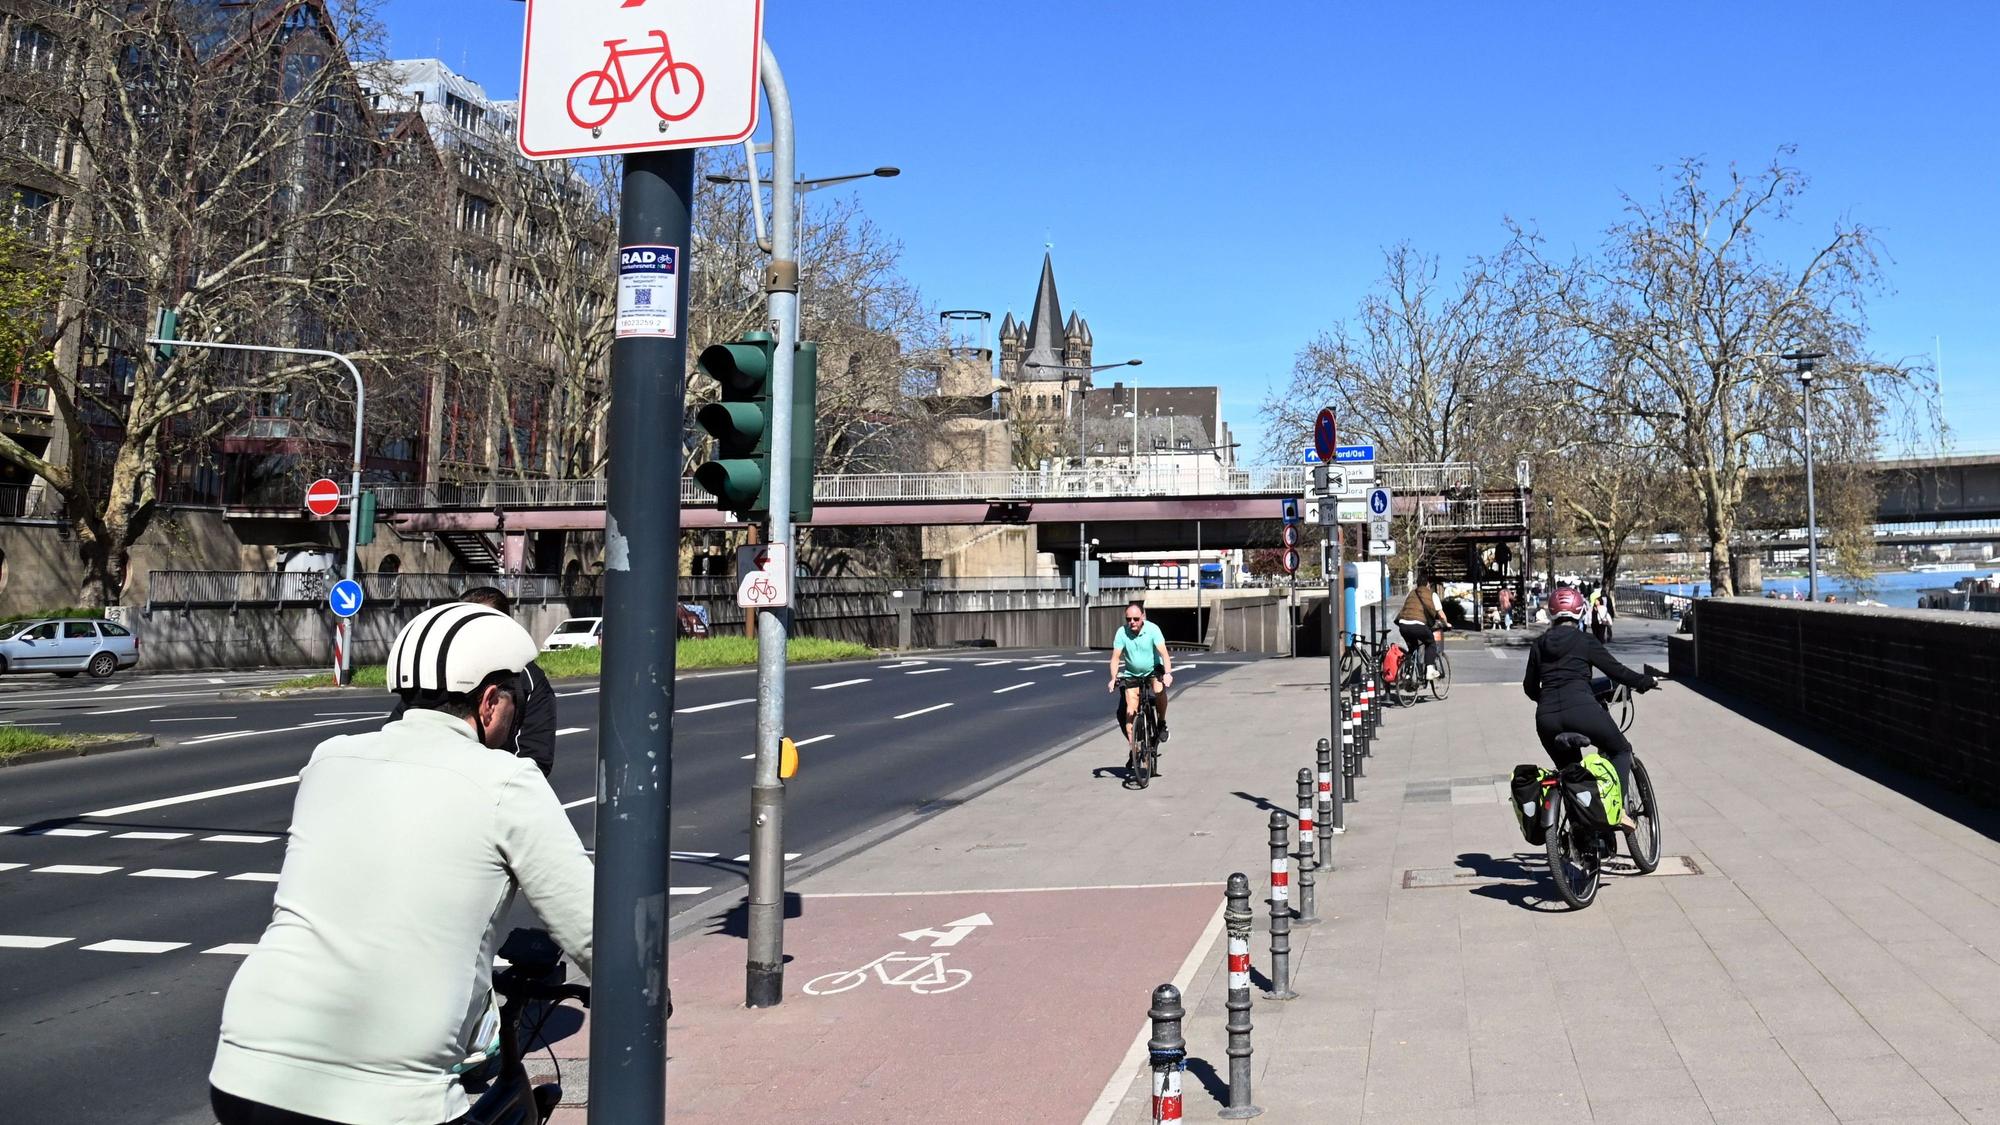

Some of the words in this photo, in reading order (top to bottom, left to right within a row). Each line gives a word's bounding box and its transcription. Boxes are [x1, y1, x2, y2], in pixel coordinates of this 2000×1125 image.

[622, 251, 656, 264] RAD
[1347, 468, 1363, 477] park
[1348, 487, 1363, 495] lora
